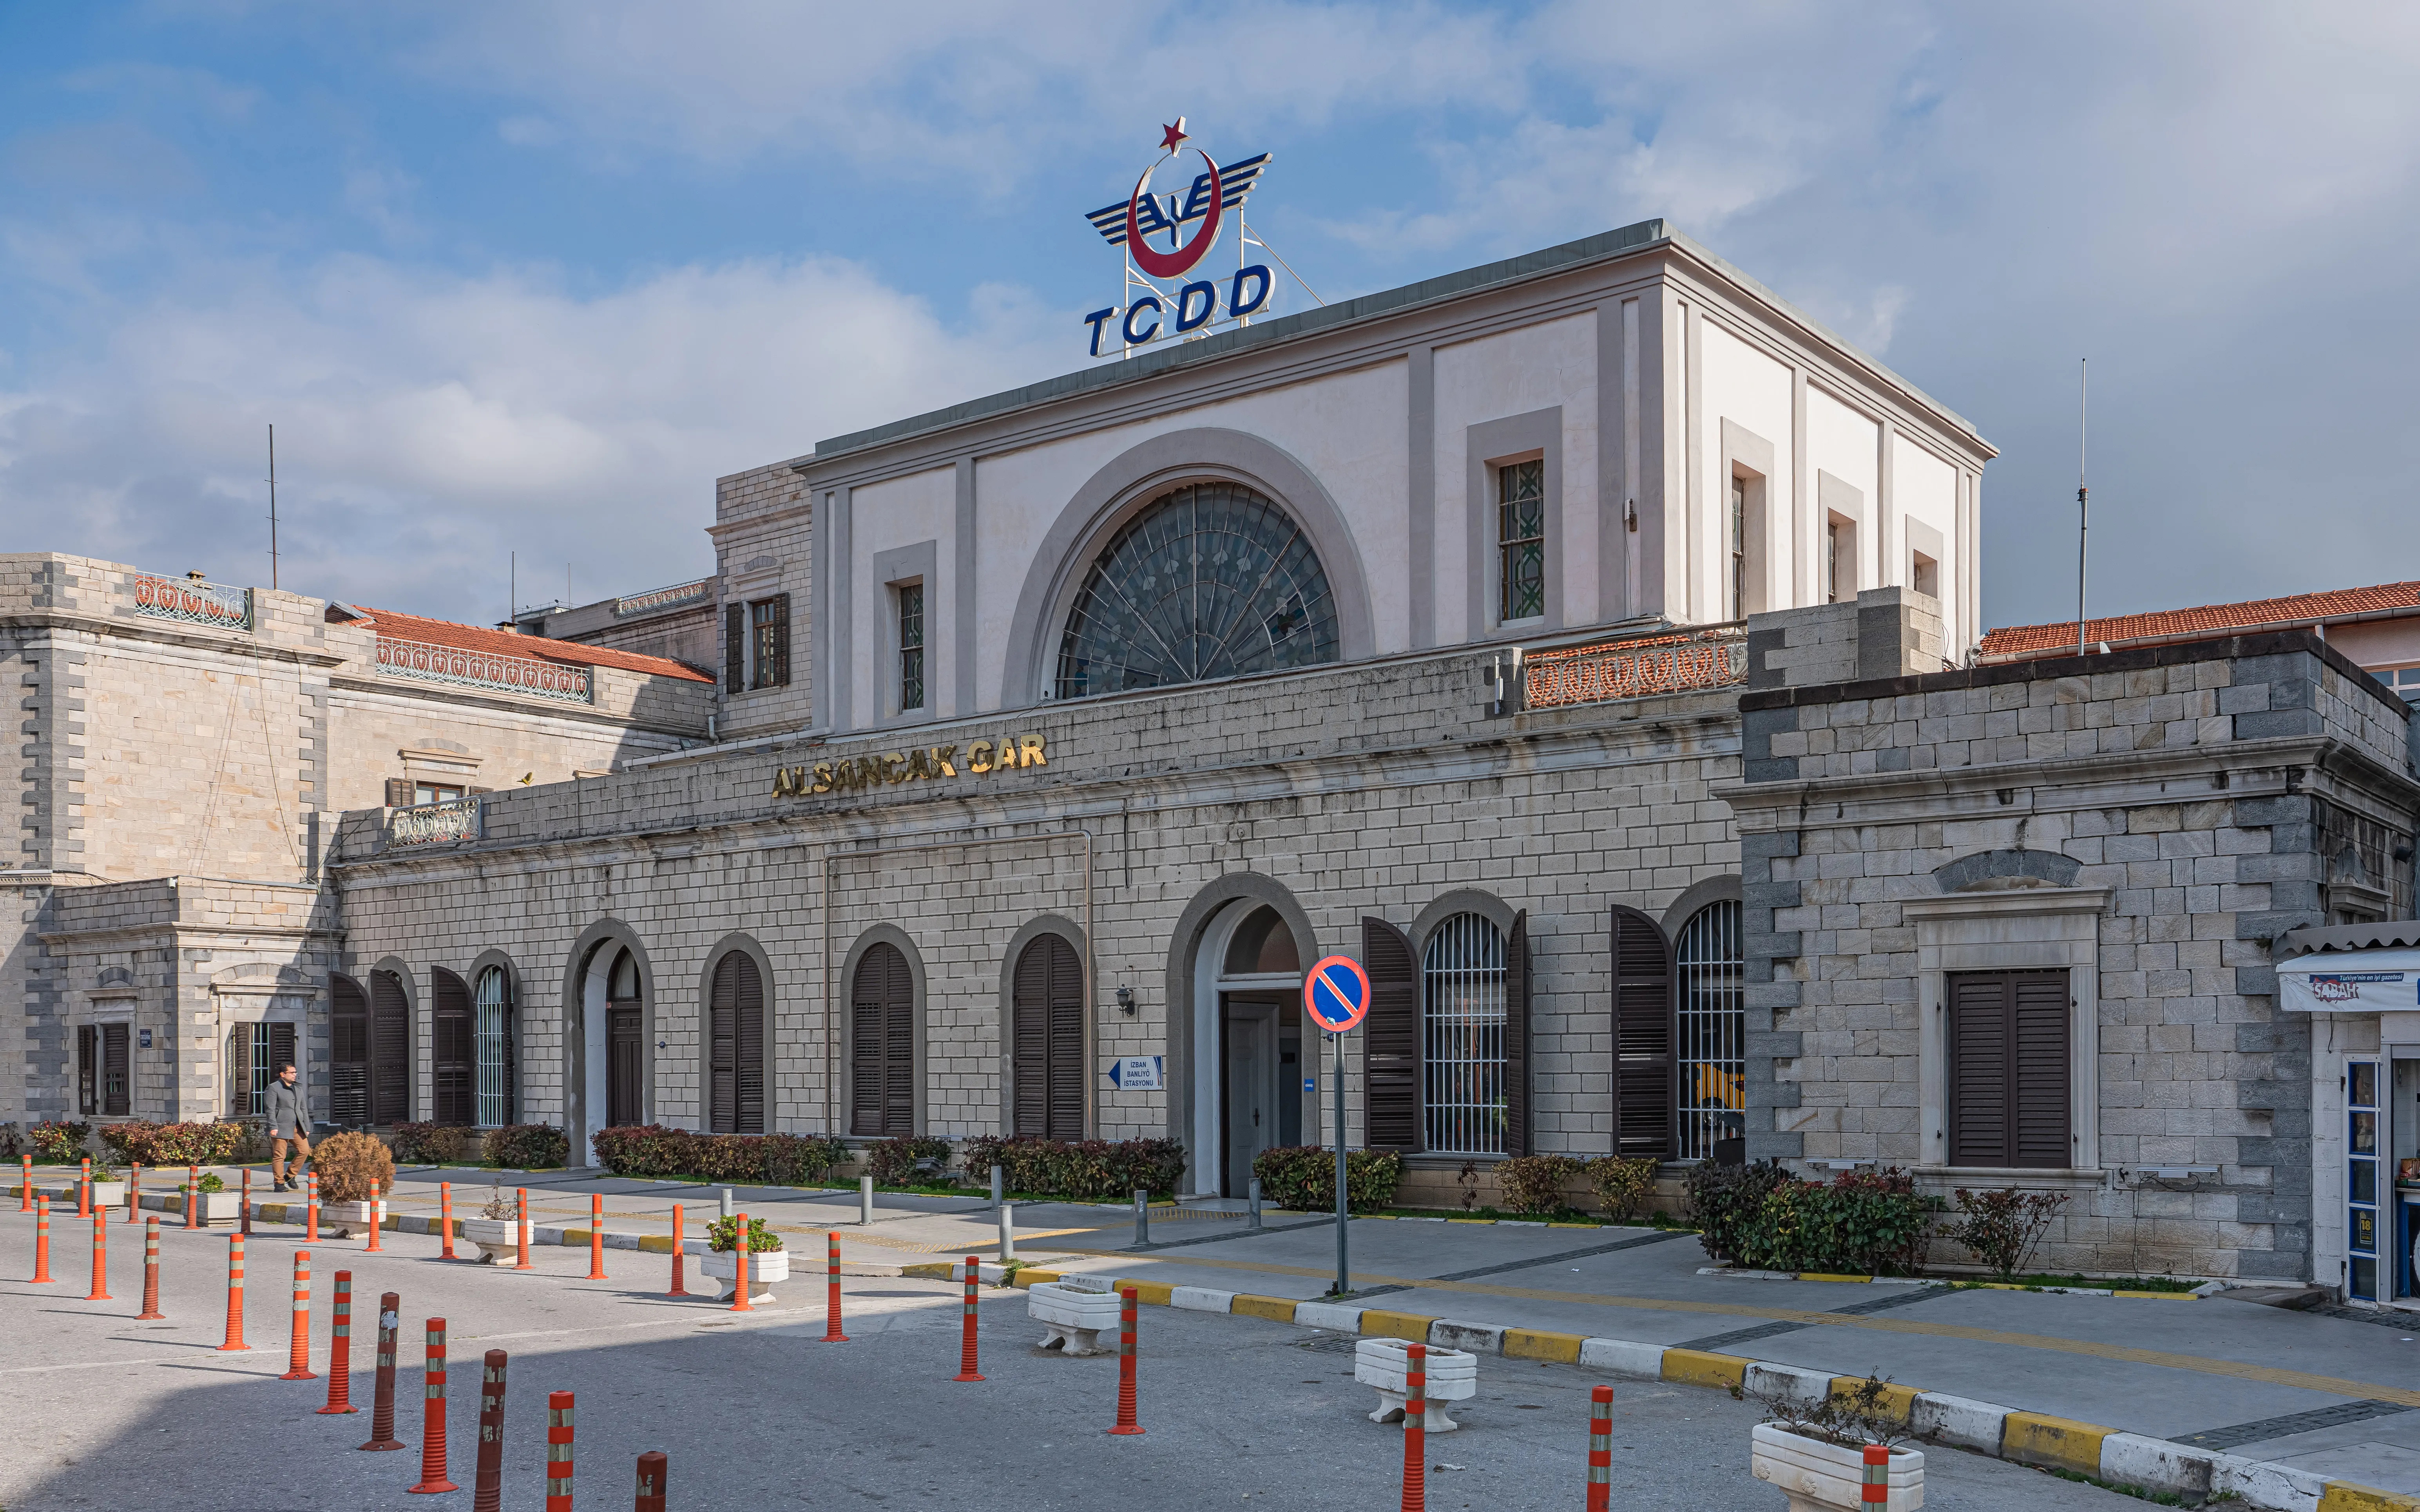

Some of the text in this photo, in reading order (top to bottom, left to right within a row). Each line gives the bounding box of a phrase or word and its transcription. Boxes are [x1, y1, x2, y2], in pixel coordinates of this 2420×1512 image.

[1084, 265, 1275, 358] TCDD
[772, 734, 1047, 798] ALSANCAK GAR
[2314, 982, 2357, 998] SABAH
[1127, 1069, 1150, 1077] BANLİYÖ
[2361, 1220, 2371, 1231] 18
